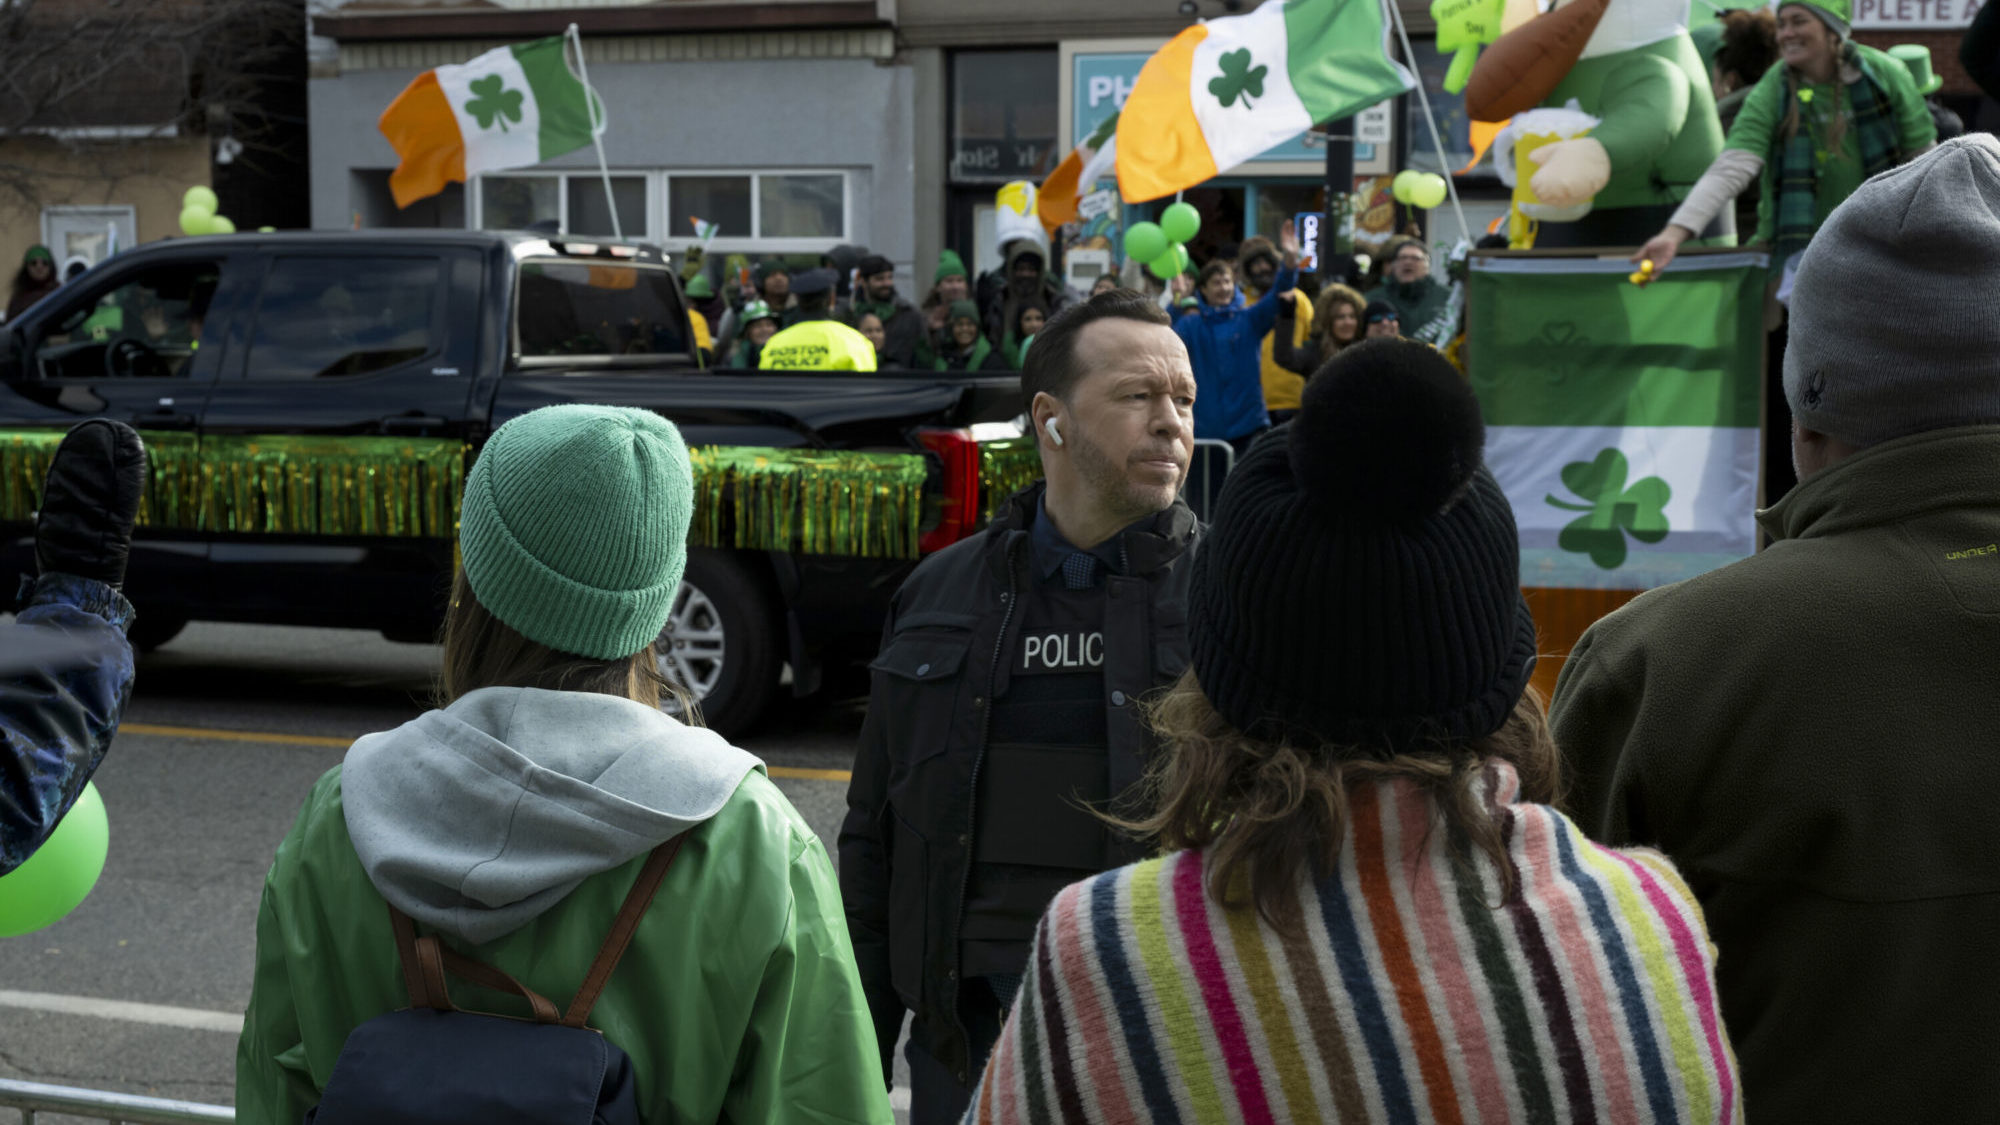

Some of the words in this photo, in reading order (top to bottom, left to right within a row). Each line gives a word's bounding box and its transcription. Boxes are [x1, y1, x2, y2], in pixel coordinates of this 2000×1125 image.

[1853, 0, 1951, 20] PLETE
[769, 345, 829, 357] BOSTON
[771, 357, 823, 370] POLICE
[1946, 544, 1998, 560] UNDER
